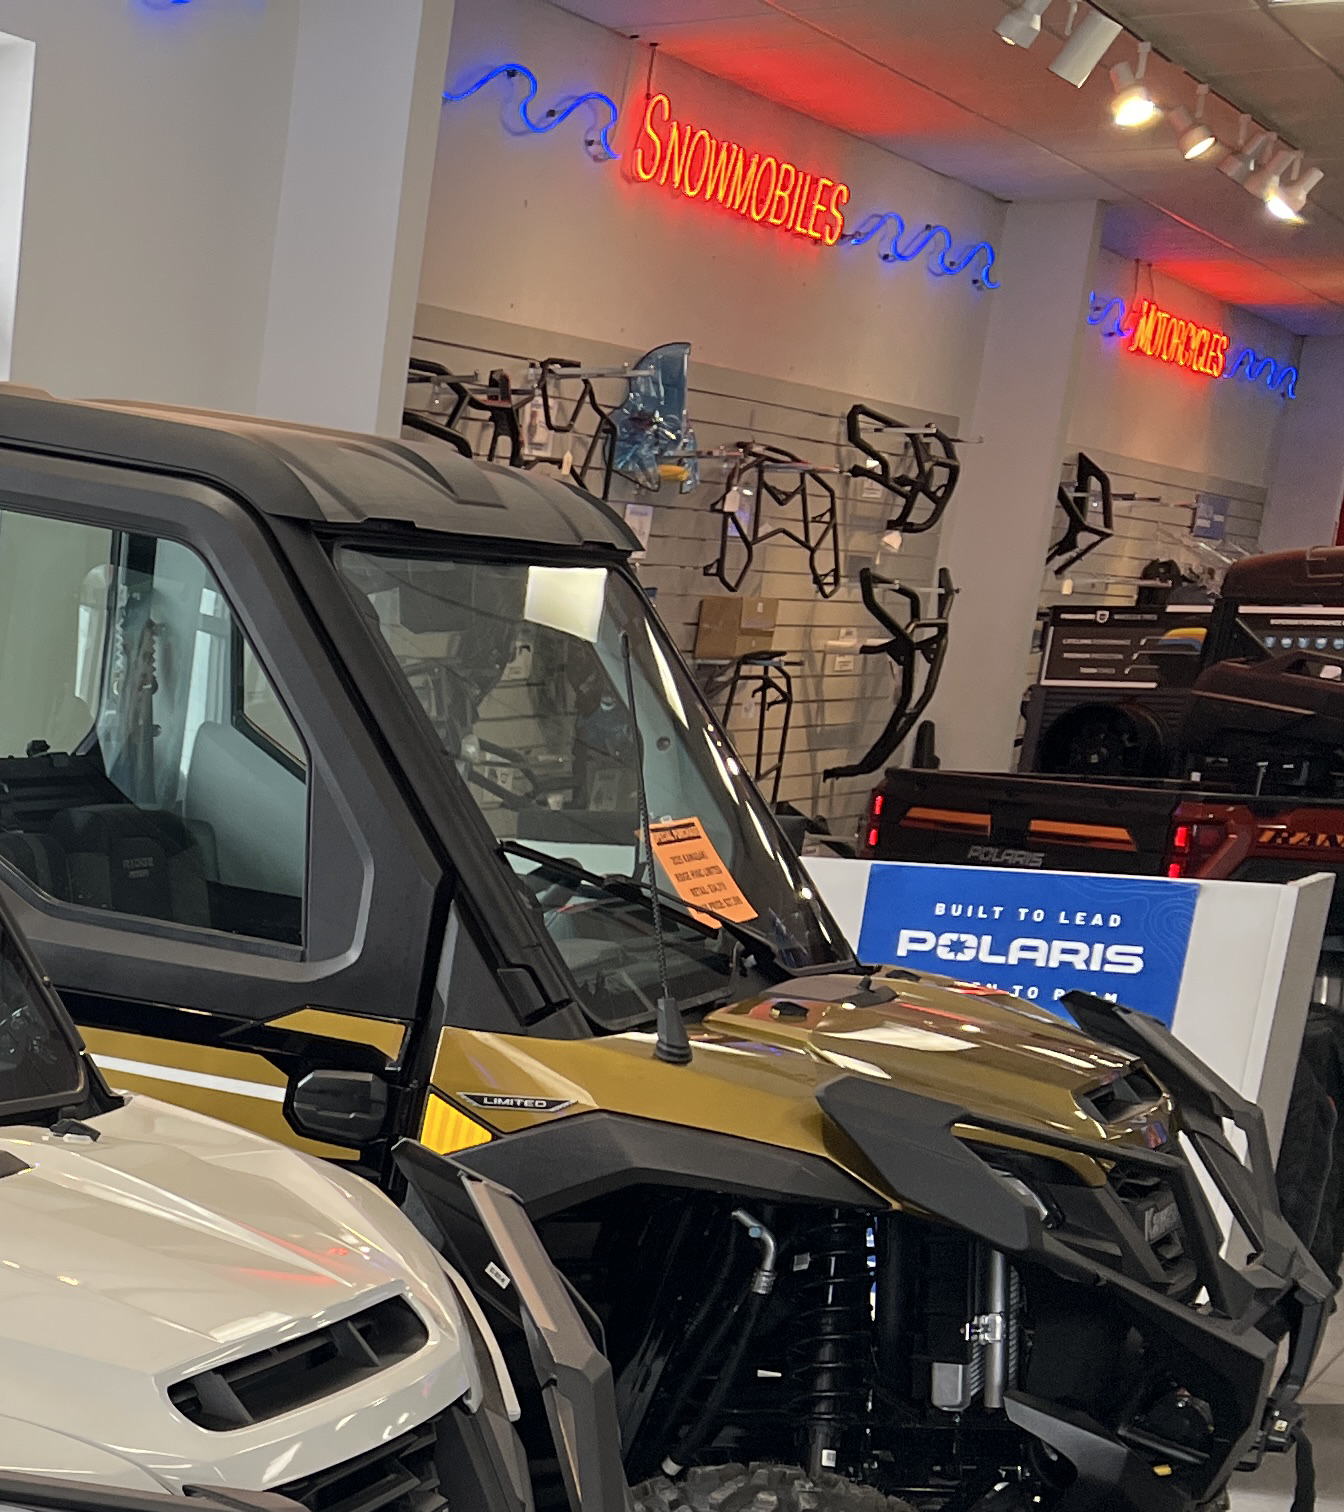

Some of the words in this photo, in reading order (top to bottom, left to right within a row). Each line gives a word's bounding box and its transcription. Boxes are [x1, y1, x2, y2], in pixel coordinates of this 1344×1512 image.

[634, 91, 850, 246] SNOWMOBILES
[1134, 300, 1230, 378] MOTORCYCLES
[967, 846, 1044, 867] POLARIS
[935, 903, 1003, 919] BUILT
[1019, 907, 1045, 922] TO
[1059, 911, 1122, 927] LEAD
[896, 929, 1145, 974] POLARIS
[1012, 985, 1039, 999] TO
[483, 1096, 547, 1108] LIMITED
